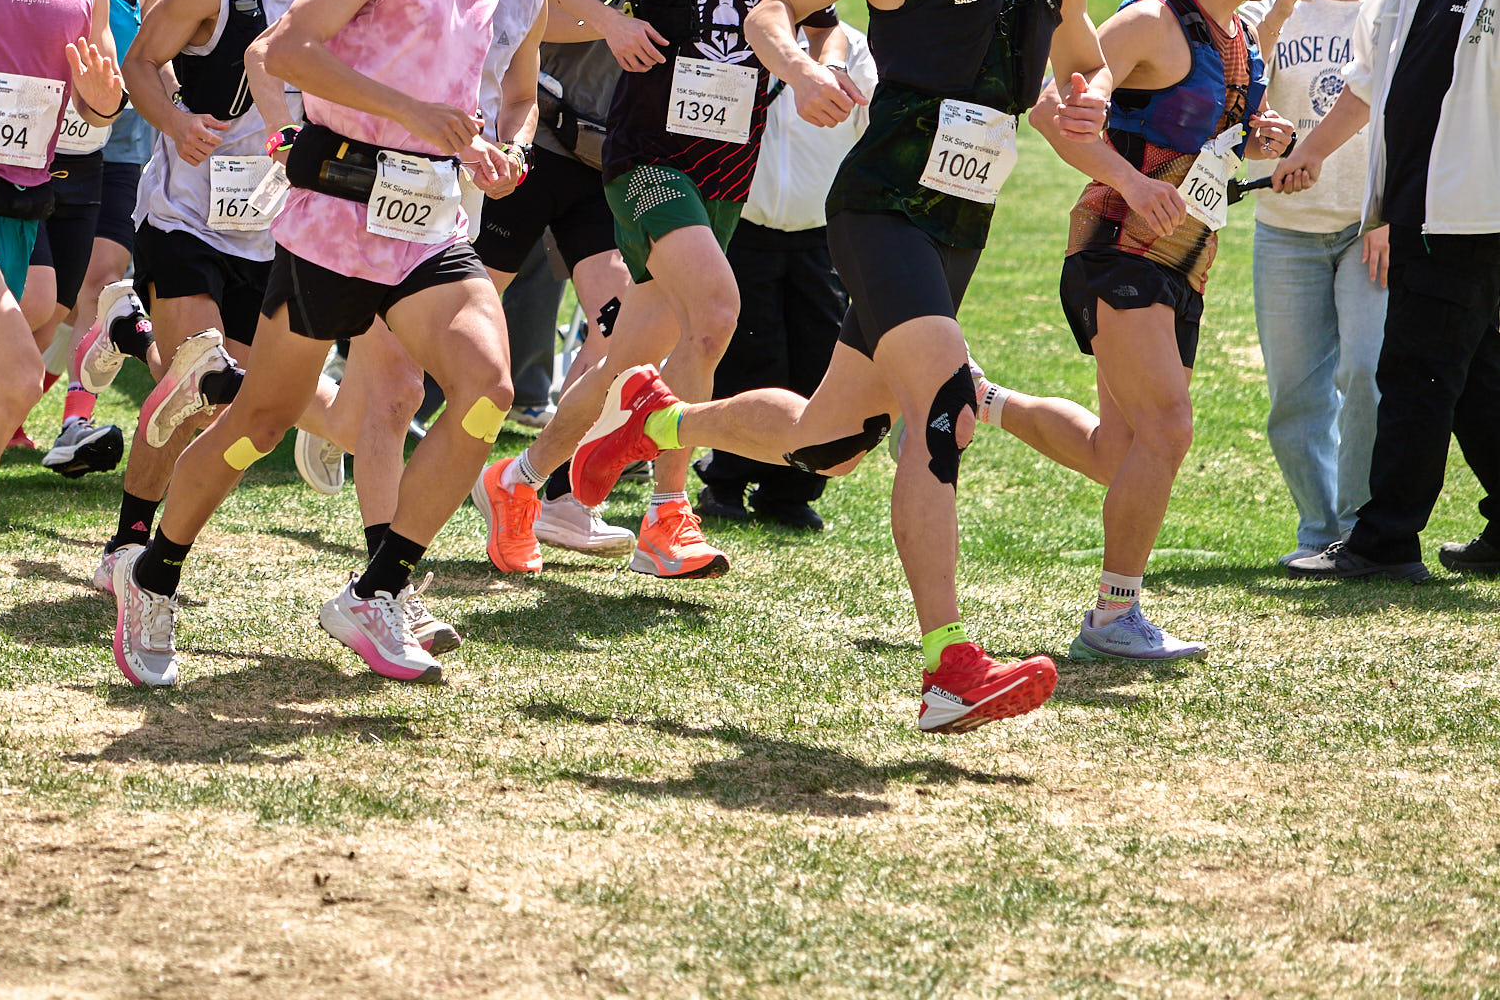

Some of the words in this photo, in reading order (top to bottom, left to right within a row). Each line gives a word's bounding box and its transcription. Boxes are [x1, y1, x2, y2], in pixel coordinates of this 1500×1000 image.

[1277, 36, 1324, 70] ROSE
[1328, 36, 1354, 64] GA
[689, 89, 706, 98] Single
[676, 100, 726, 125] 1394
[941, 134, 954, 143] 15K
[954, 137, 974, 150] Single
[938, 150, 991, 184] 1004
[226, 186, 241, 194] Single
[380, 180, 393, 190] 15K
[393, 184, 413, 197] Single
[1188, 177, 1222, 210] 1607
[376, 196, 431, 227] 1002
[930, 684, 963, 704] SALOMON
